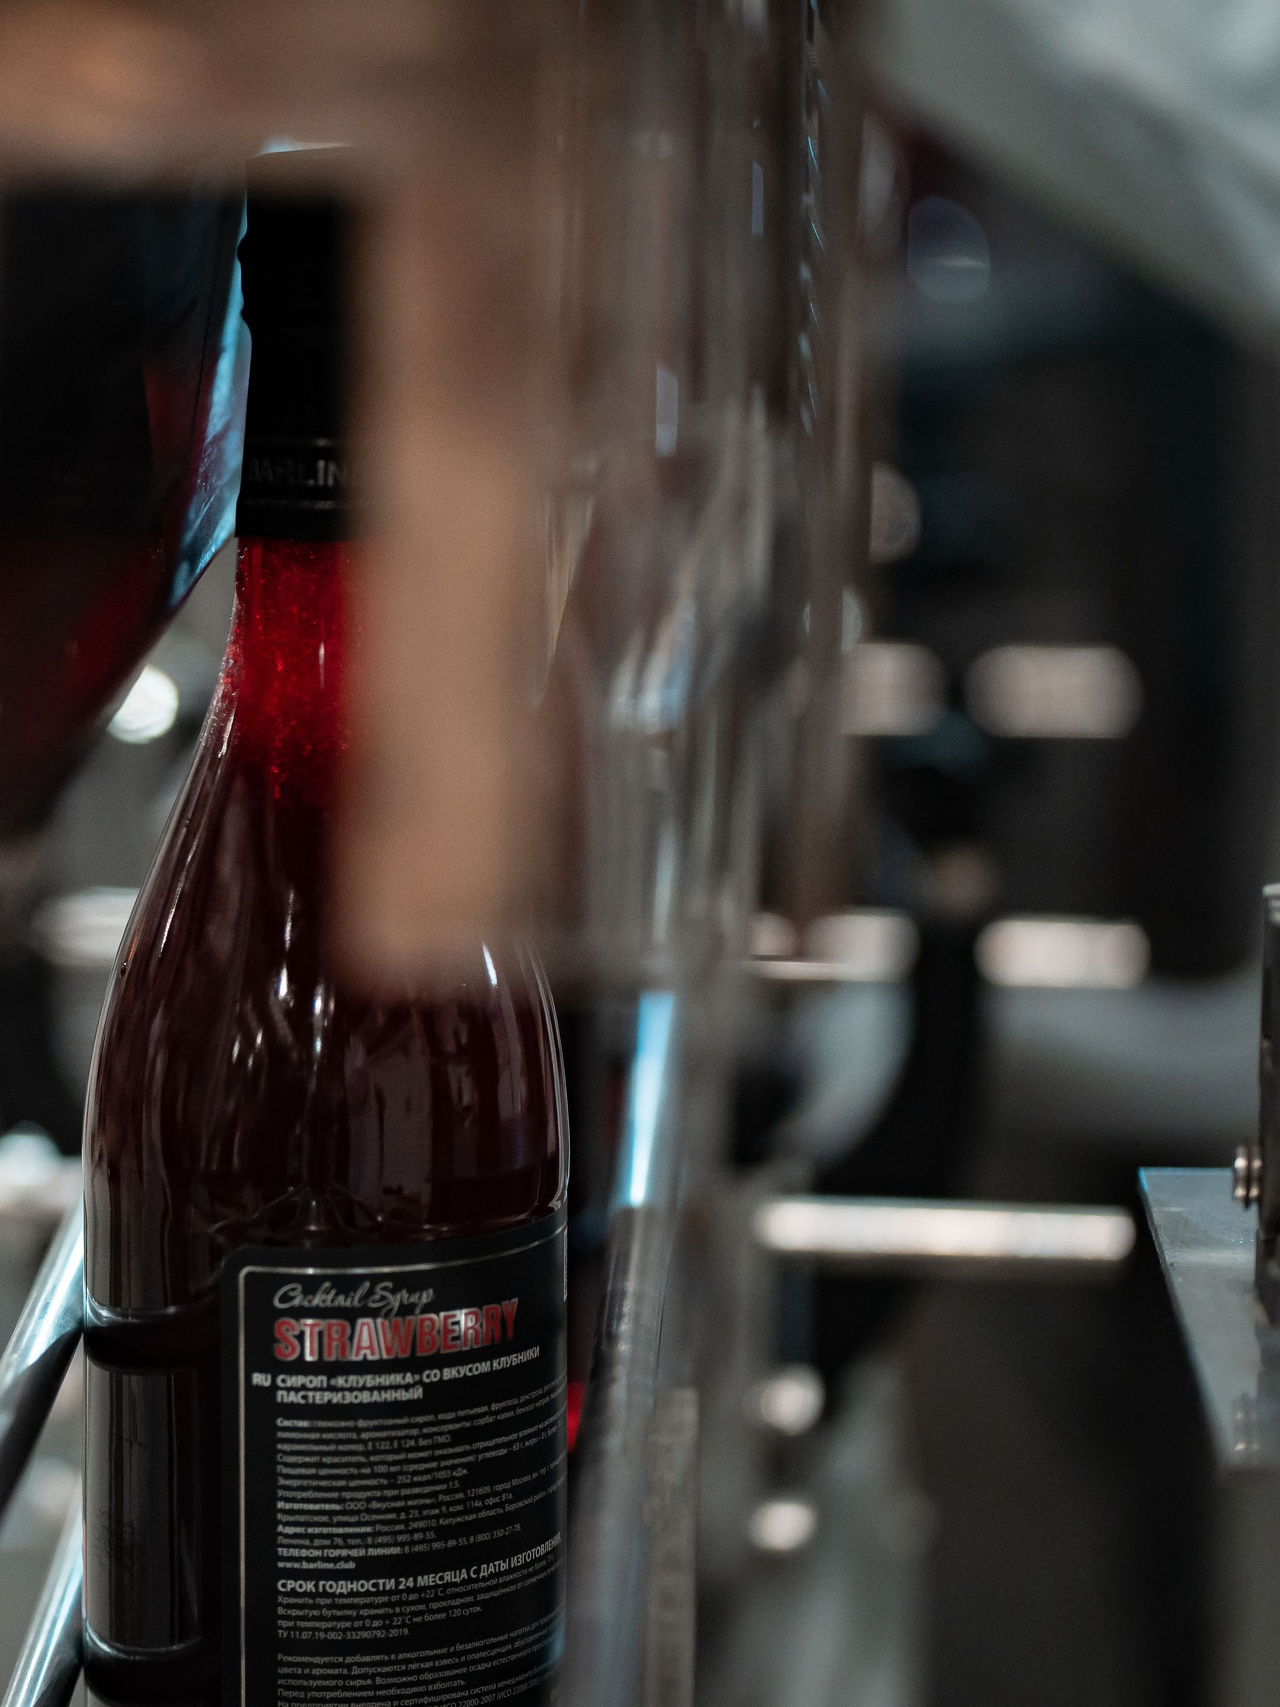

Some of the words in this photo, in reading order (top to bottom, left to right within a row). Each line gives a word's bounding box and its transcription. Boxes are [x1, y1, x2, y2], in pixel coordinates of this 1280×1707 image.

[249, 457, 342, 488] BARLIN
[272, 1281, 368, 1309] Cocktail
[366, 1281, 436, 1318] Syrup
[273, 1297, 519, 1362] STRAWBERRY
[251, 1372, 272, 1387] RU
[276, 1375, 327, 1388] СИРОП
[329, 1371, 420, 1388] «КЛУБНИКА»
[422, 1368, 441, 1383] СО
[442, 1360, 491, 1380] ВКУСОМ
[492, 1345, 540, 1371] КЛУБНИКИ
[276, 1386, 424, 1404] ПАСТЕРИЗОВАННЫЙ
[277, 1488, 339, 1500] Употребление
[341, 1490, 381, 1500] продукта
[382, 1489, 399, 1498] при
[400, 1483, 447, 1497] разведении
[345, 1501, 366, 1510] ООО
[277, 1547, 322, 1556] ТЕЛЕФОН
[324, 1547, 366, 1556] ГОРЯЧЕЙ
[367, 1545, 403, 1555] ЛИНИИ:
[404, 1544, 410, 1553] 8
[411, 1541, 431, 1554] (495)
[432, 1535, 468, 1550] 995-89-55,
[469, 1534, 475, 1543] 8
[475, 1530, 491, 1544] (800)
[492, 1520, 521, 1538] 350-27-78.
[277, 1559, 357, 1570] www.barline.club
[277, 1580, 316, 1592] СРОК
[318, 1578, 396, 1595] ГОДНОСТИ
[398, 1576, 414, 1589] 24
[417, 1568, 468, 1588] МЕСЯЦА
[470, 1566, 478, 1579] С
[479, 1558, 508, 1580] ДАТЫ
[277, 1595, 314, 1605] Хранить
[315, 1598, 333, 1606] при
[334, 1596, 389, 1606] температуре
[402, 1592, 407, 1601] 0
[408, 1593, 419, 1602] до
[446, 1576, 498, 1595] относительной
[499, 1567, 527, 1584] влажности
[277, 1606, 320, 1618] Вскрытую
[322, 1608, 358, 1618] бутылку
[359, 1607, 393, 1617] хранить
[402, 1603, 427, 1614] сухом,
[429, 1595, 474, 1611] прохладном,
[517, 1581, 523, 1589] от
[277, 1620, 295, 1629] при
[296, 1621, 352, 1630] температуре
[365, 1618, 370, 1627] 0
[372, 1619, 383, 1628] до
[412, 1615, 423, 1623] не
[424, 1611, 447, 1621] более
[449, 1607, 461, 1618] 120
[462, 1605, 483, 1617] суток.
[277, 1628, 288, 1639] ТУ
[277, 1653, 343, 1665] Рекомендуется
[345, 1654, 389, 1665] добавлять
[398, 1646, 448, 1660] алкогольные
[456, 1632, 509, 1651] безалкогольные
[510, 1624, 531, 1638] напитки
[277, 1667, 302, 1675] цвета
[311, 1668, 350, 1677] аромата.
[351, 1664, 406, 1676] Допускаются
[435, 1656, 459, 1667] взвесь
[277, 1679, 343, 1688] используемого
[345, 1679, 373, 1688] сырья.
[375, 1675, 417, 1685] Возможно
[418, 1666, 467, 1682] образование
[469, 1661, 491, 1672] осадка
[492, 1646, 531, 1667] естественного
[277, 1688, 305, 1700] Перед
[306, 1689, 374, 1700] употреблением
[375, 1685, 426, 1696] необходимо
[428, 1679, 466, 1691] взболтать.
[400, 1689, 468, 1707] сертифицирована
[469, 1683, 496, 1695] система
[497, 1669, 533, 1689] менеджмента
[458, 1692, 495, 1707] 22000-2007
[495, 1687, 511, 1702] (ИСО
